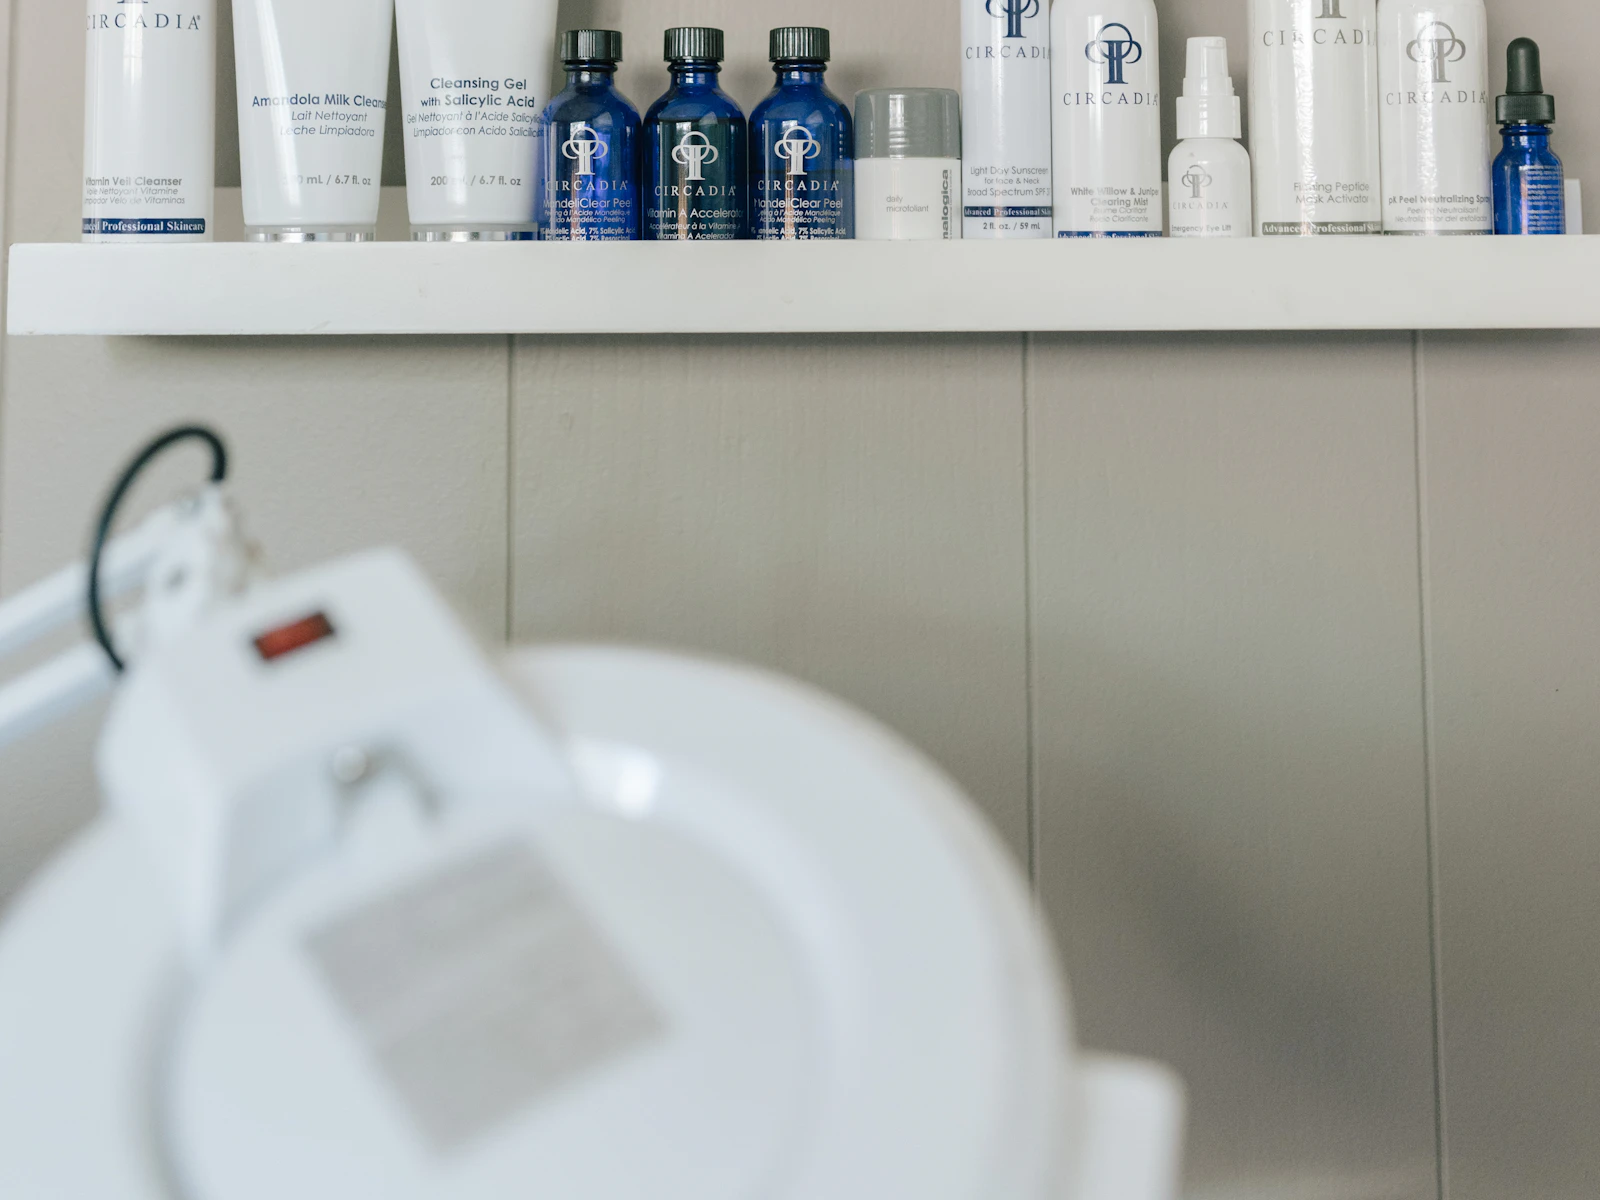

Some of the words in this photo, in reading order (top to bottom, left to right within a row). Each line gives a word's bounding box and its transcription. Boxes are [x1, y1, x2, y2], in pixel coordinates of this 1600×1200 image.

[430, 77, 499, 91] Cleansing
[504, 78, 527, 90] Gel
[324, 93, 350, 106] Milk
[420, 97, 441, 107] with
[444, 93, 502, 108] Salicylic
[506, 95, 535, 108] Acid
[291, 110, 312, 121] Lait
[315, 110, 368, 122] Nettoyant
[419, 110, 463, 123] Nettoyant
[474, 110, 509, 122] l'Acide
[319, 124, 375, 137] Limpiadora
[413, 126, 454, 138] Limpiador
[456, 126, 476, 135] con
[970, 166, 988, 176] Light
[990, 166, 1009, 176] Day
[1011, 166, 1049, 175] Sunscreen
[112, 176, 132, 186] Veil
[134, 176, 183, 186] Cleanser
[334, 174, 350, 185] 6.7
[430, 176, 448, 186] 200
[479, 175, 496, 185] 6.7
[99, 187, 139, 196] Nettoyant
[140, 186, 179, 195] Vitamine
[967, 187, 988, 196] Broad
[989, 187, 1033, 198] Spectrum
[1070, 187, 1094, 196] White
[1097, 187, 1127, 196] Willow
[1335, 182, 1370, 193] Peptide
[144, 196, 186, 205] Vitaminas
[613, 197, 633, 208] Peel
[823, 198, 843, 208] Peel
[886, 195, 904, 204] daily
[1090, 197, 1131, 207] Clearing
[1133, 197, 1149, 206] Mist
[1295, 194, 1325, 204] Mask
[1399, 195, 1418, 204] Peel
[1420, 195, 1475, 205] Neutralizing
[647, 207, 677, 218] Vitamin
[690, 207, 743, 218] Accelerator
[804, 209, 841, 218] Mandélique
[886, 204, 929, 213] microfoliant
[994, 208, 1040, 216] Professional
[1118, 206, 1147, 214] Clarifiant
[1436, 206, 1479, 214] Neutralisant
[566, 215, 602, 223] Mandélico
[603, 216, 626, 224] Peeling
[812, 216, 836, 224] Peeling
[1111, 215, 1149, 223] Clarificante
[102, 220, 164, 231] Professional
[166, 220, 204, 231] Skincare
[649, 221, 690, 230] Accélérateur
[708, 221, 737, 230] Vitamine
[1263, 223, 1306, 233] Advanced
[1310, 223, 1366, 232] Professional
[599, 227, 625, 235] Salicylic
[656, 232, 686, 240] Vitamina
[695, 232, 735, 240] Acelerador
[809, 227, 835, 236] Salicylic
